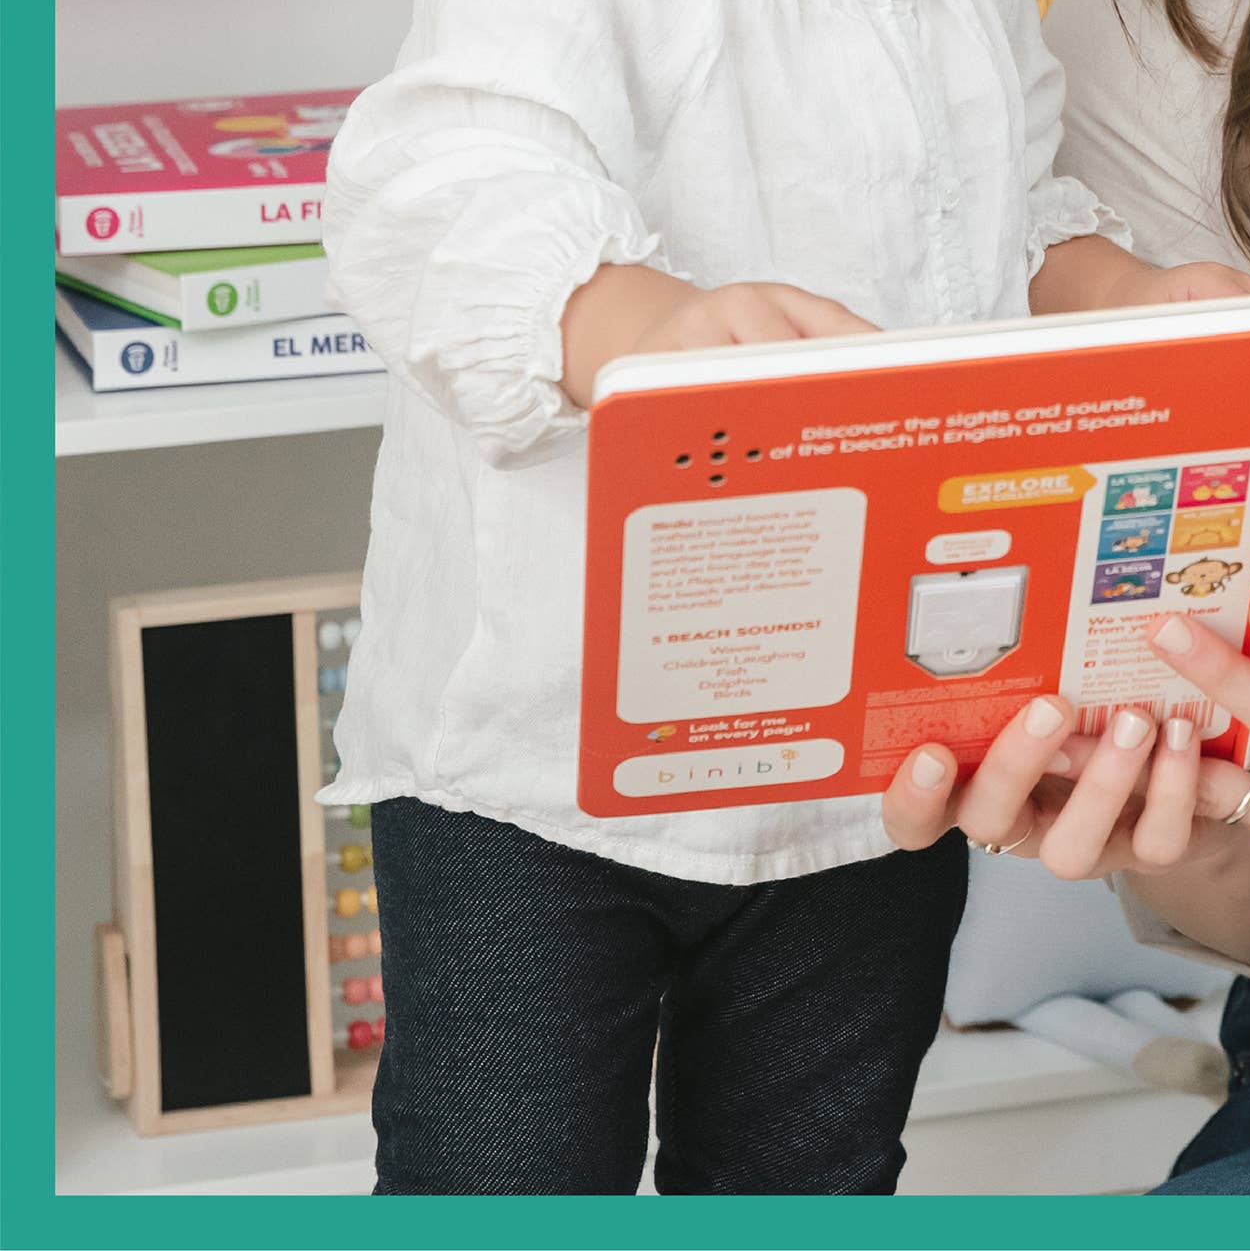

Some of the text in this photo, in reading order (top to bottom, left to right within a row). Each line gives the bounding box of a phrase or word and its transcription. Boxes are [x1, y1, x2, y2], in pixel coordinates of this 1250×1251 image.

[260, 203, 291, 223] LA
[273, 337, 302, 358] EL
[801, 395, 1147, 442] Discover the sights and sounds
[769, 443, 794, 461] of
[798, 441, 835, 457] the
[840, 432, 914, 454] beach
[918, 431, 939, 447] in
[943, 422, 1022, 444] English
[1026, 417, 1072, 437] and
[962, 474, 1068, 496] EXPLORE
[668, 629, 731, 643] BEACH
[737, 619, 822, 636] SOUNDS!
[663, 650, 807, 671] Children Laughing
[716, 666, 747, 677] Fish
[698, 676, 768, 690] Dolphins
[713, 689, 752, 700] Birds
[688, 721, 811, 744] on every page!
[689, 716, 787, 734] Look for me
